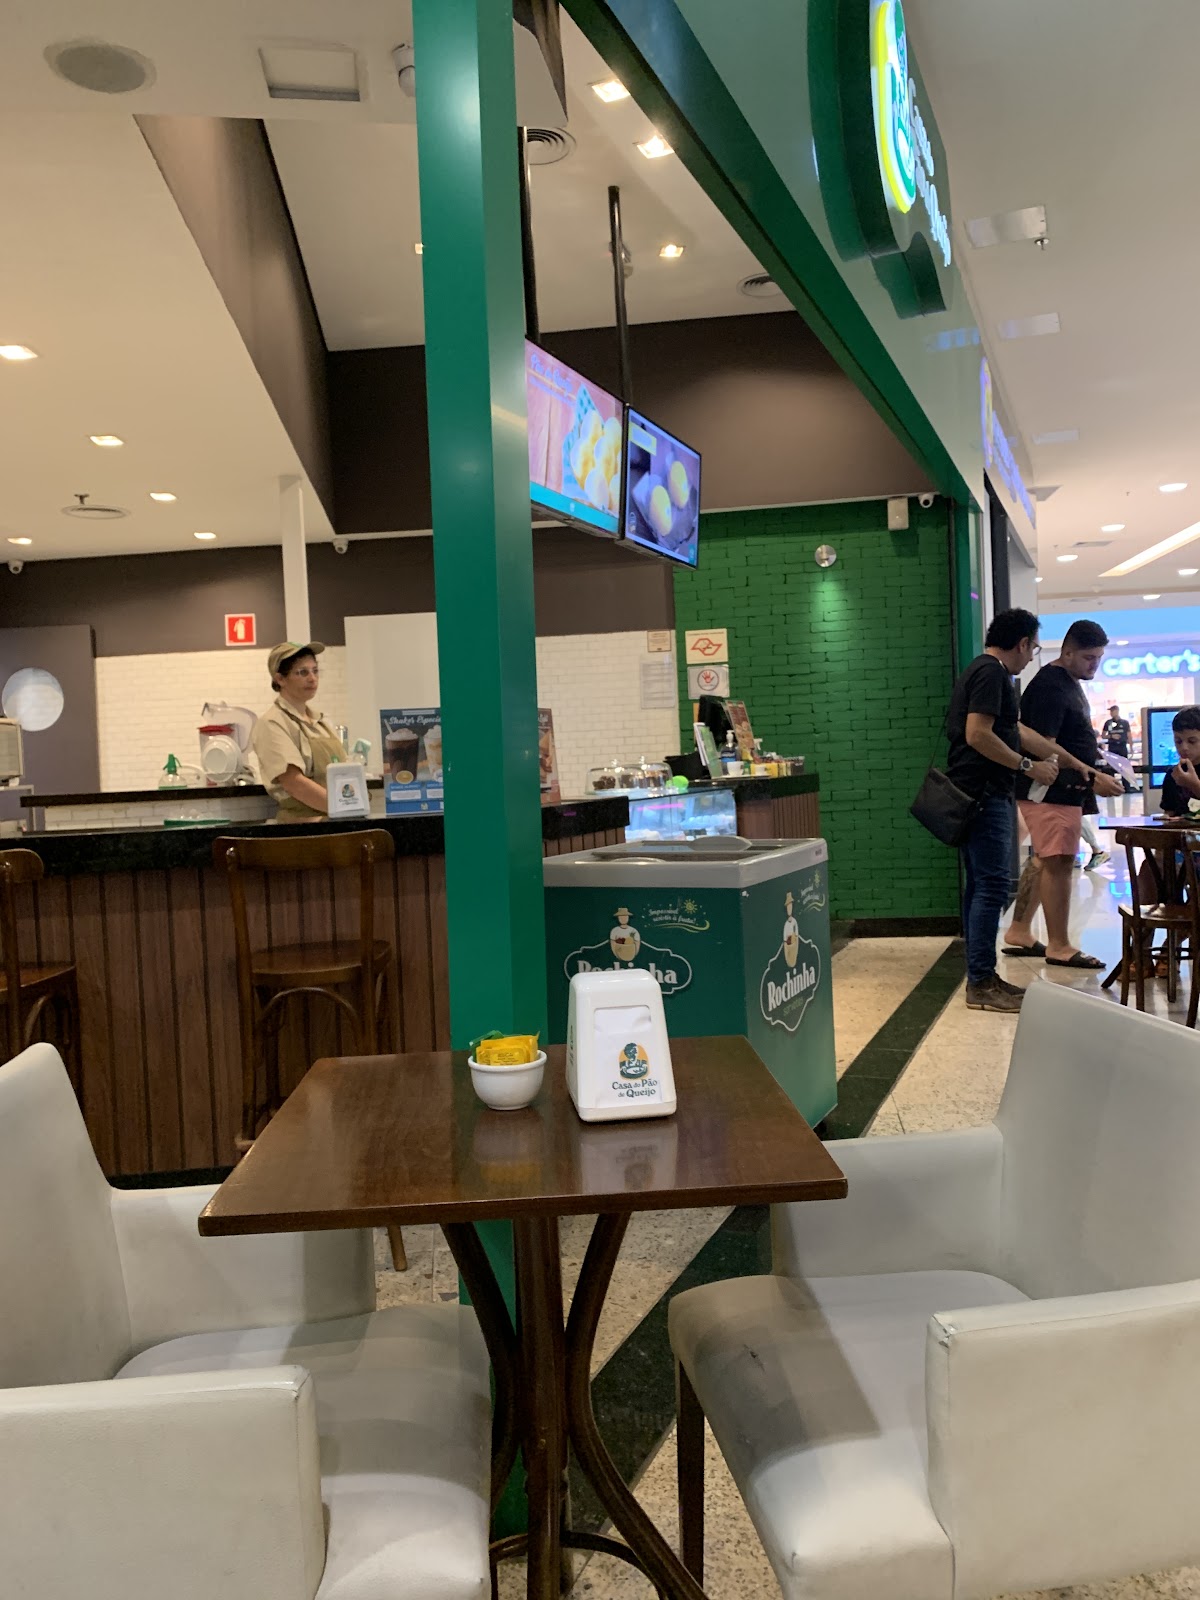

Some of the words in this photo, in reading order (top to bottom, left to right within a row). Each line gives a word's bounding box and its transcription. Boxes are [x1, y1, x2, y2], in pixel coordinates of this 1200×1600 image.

[1103, 649, 1200, 676] carter's
[767, 962, 816, 1012] Rochinha
[612, 1081, 633, 1090] Casa
[641, 1078, 658, 1088] Pão
[626, 1088, 656, 1098] Queijo
